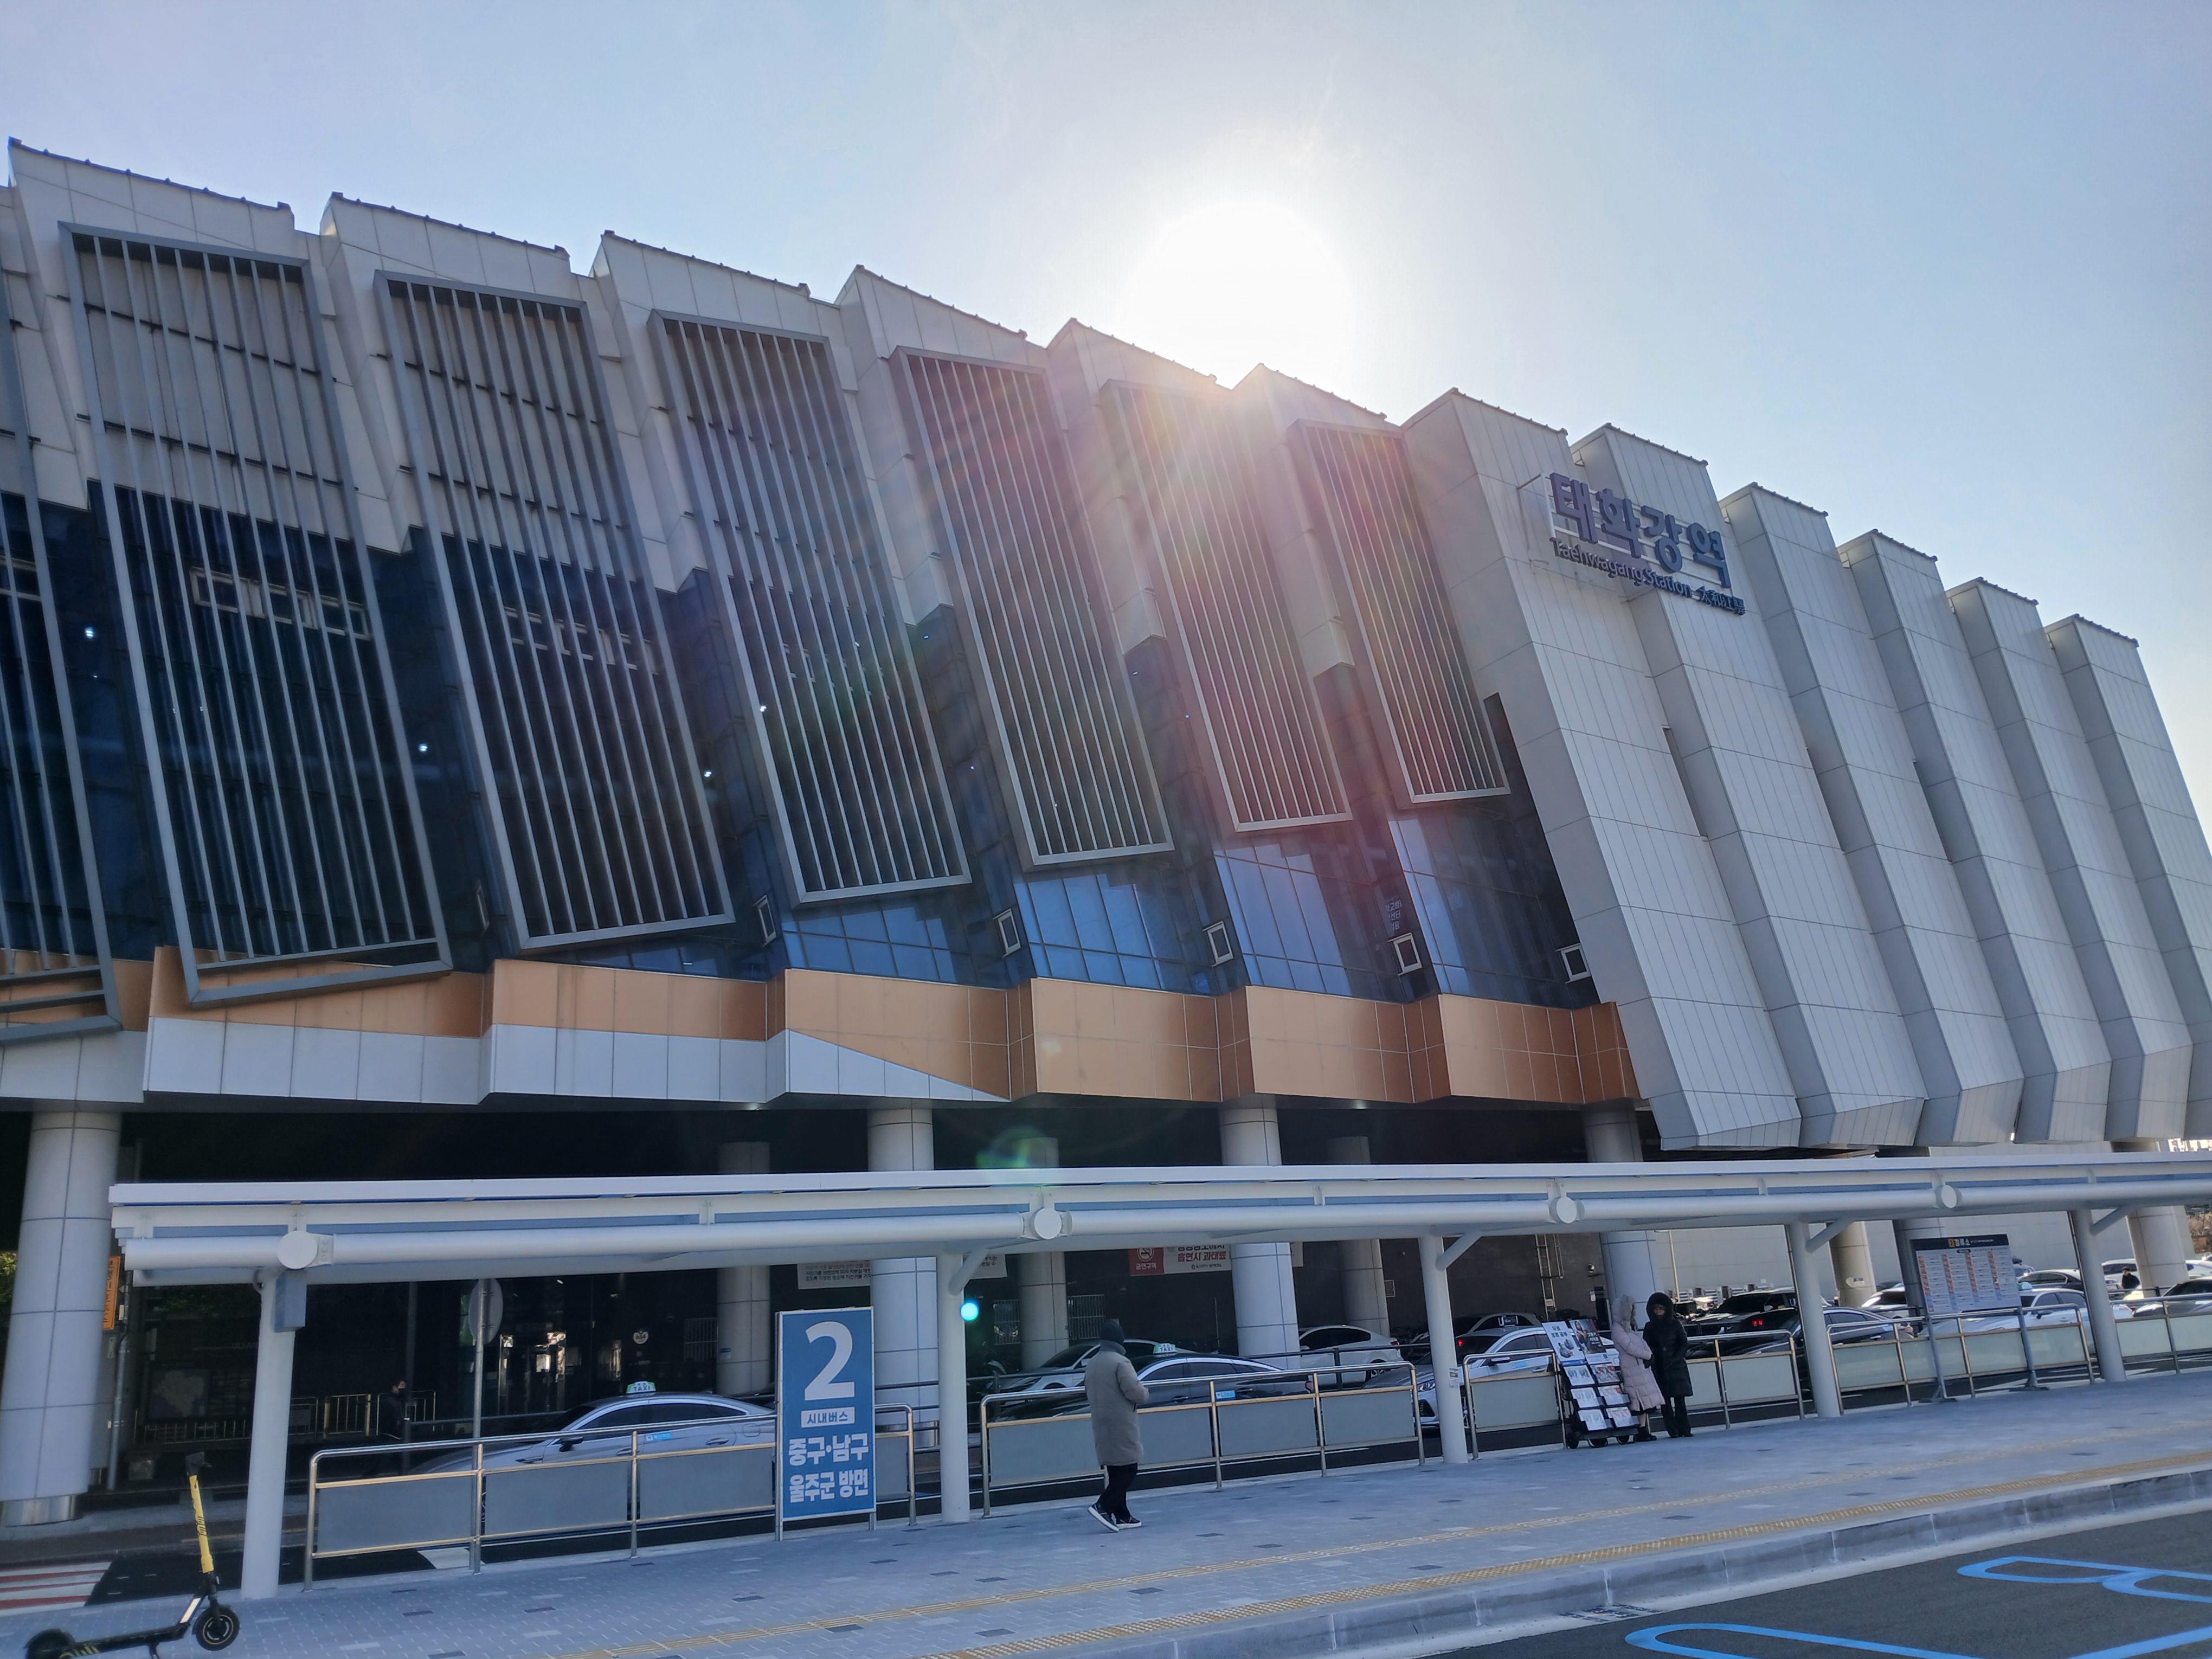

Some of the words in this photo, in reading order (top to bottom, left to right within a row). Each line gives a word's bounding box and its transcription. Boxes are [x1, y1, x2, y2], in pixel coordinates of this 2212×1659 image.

[1549, 472, 1731, 589] 태화강역
[1549, 537, 1647, 587] Taehwagang
[1643, 568, 1693, 598] Station
[1136, 1262, 1156, 1270] 금연구역
[1178, 1252, 1201, 1262] 흡연시
[1203, 1251, 1226, 1261] 과태료
[805, 1321, 855, 1401] 2
[807, 1411, 848, 1424] 시내버스
[790, 1471, 835, 1503] 울주군
[839, 1468, 869, 1498] 방면
